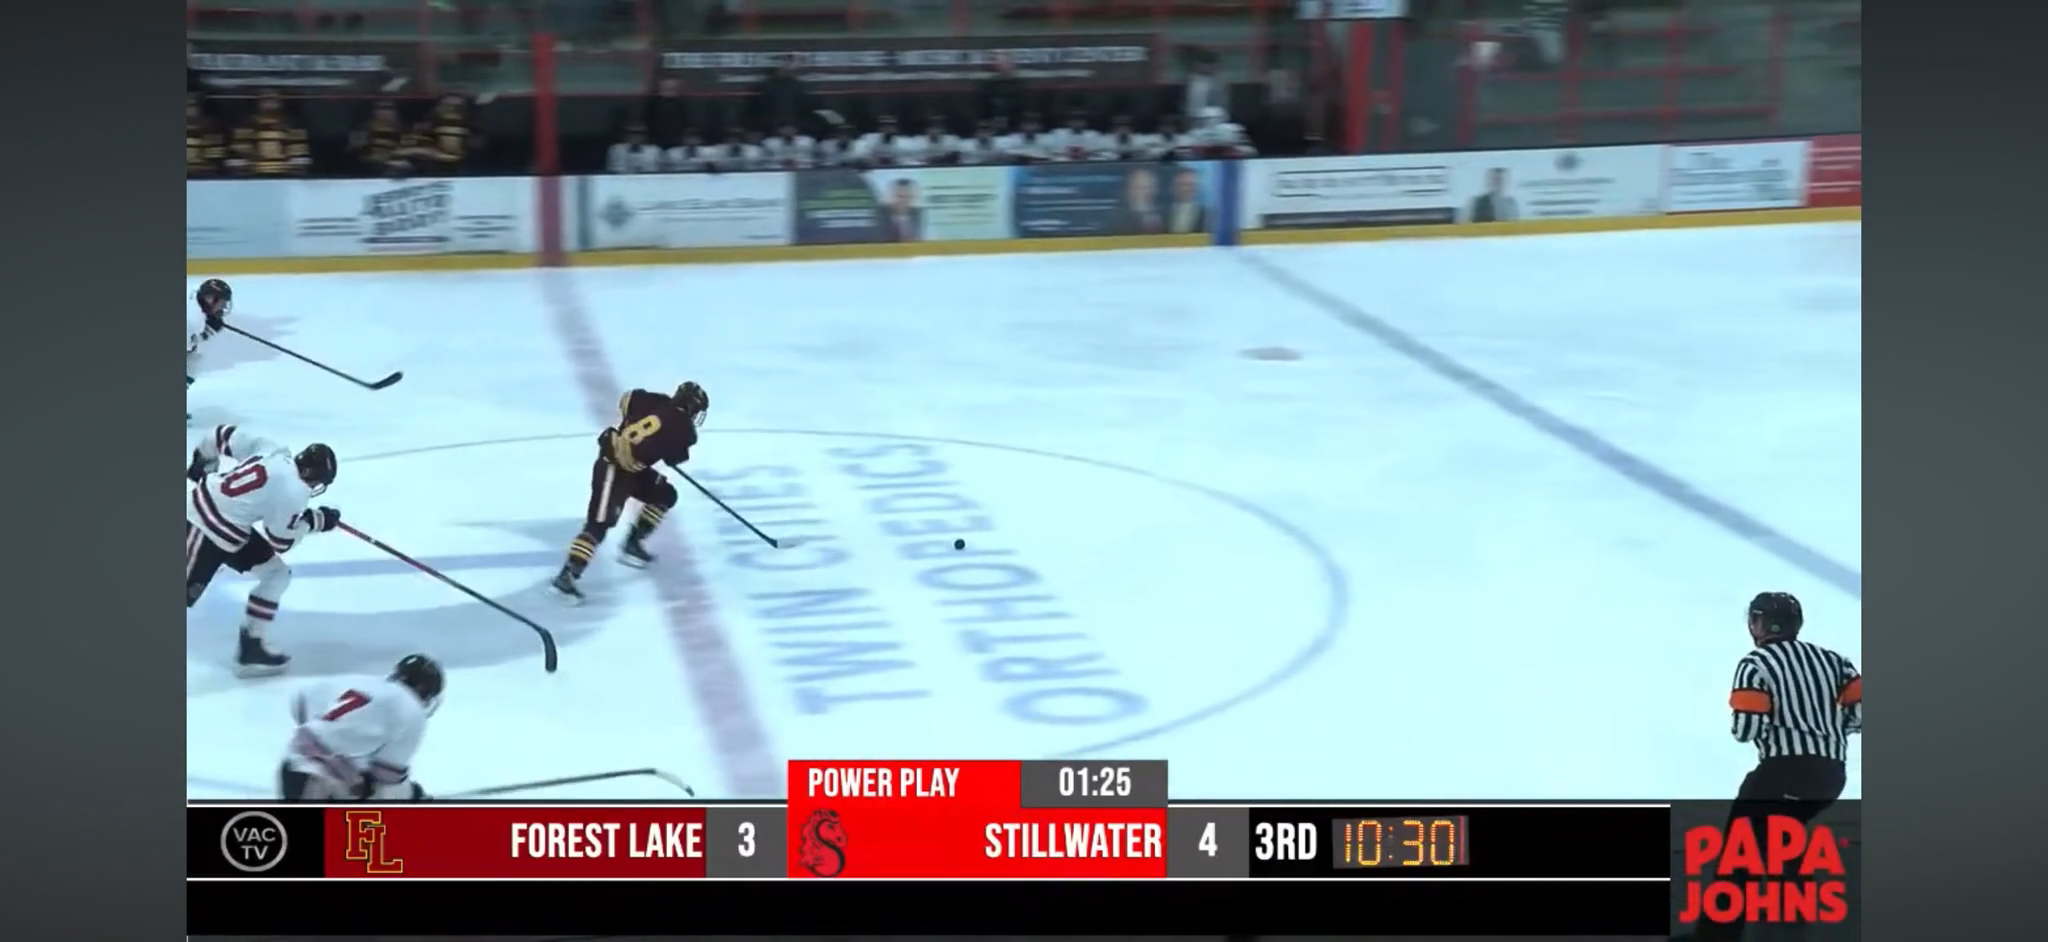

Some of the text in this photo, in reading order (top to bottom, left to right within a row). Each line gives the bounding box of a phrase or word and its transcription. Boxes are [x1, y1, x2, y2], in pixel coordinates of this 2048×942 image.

[621, 414, 662, 445] 8
[691, 464, 932, 714] TWIN CITIES
[823, 443, 1149, 725] ORTHOPEDICS
[321, 688, 374, 722] 7
